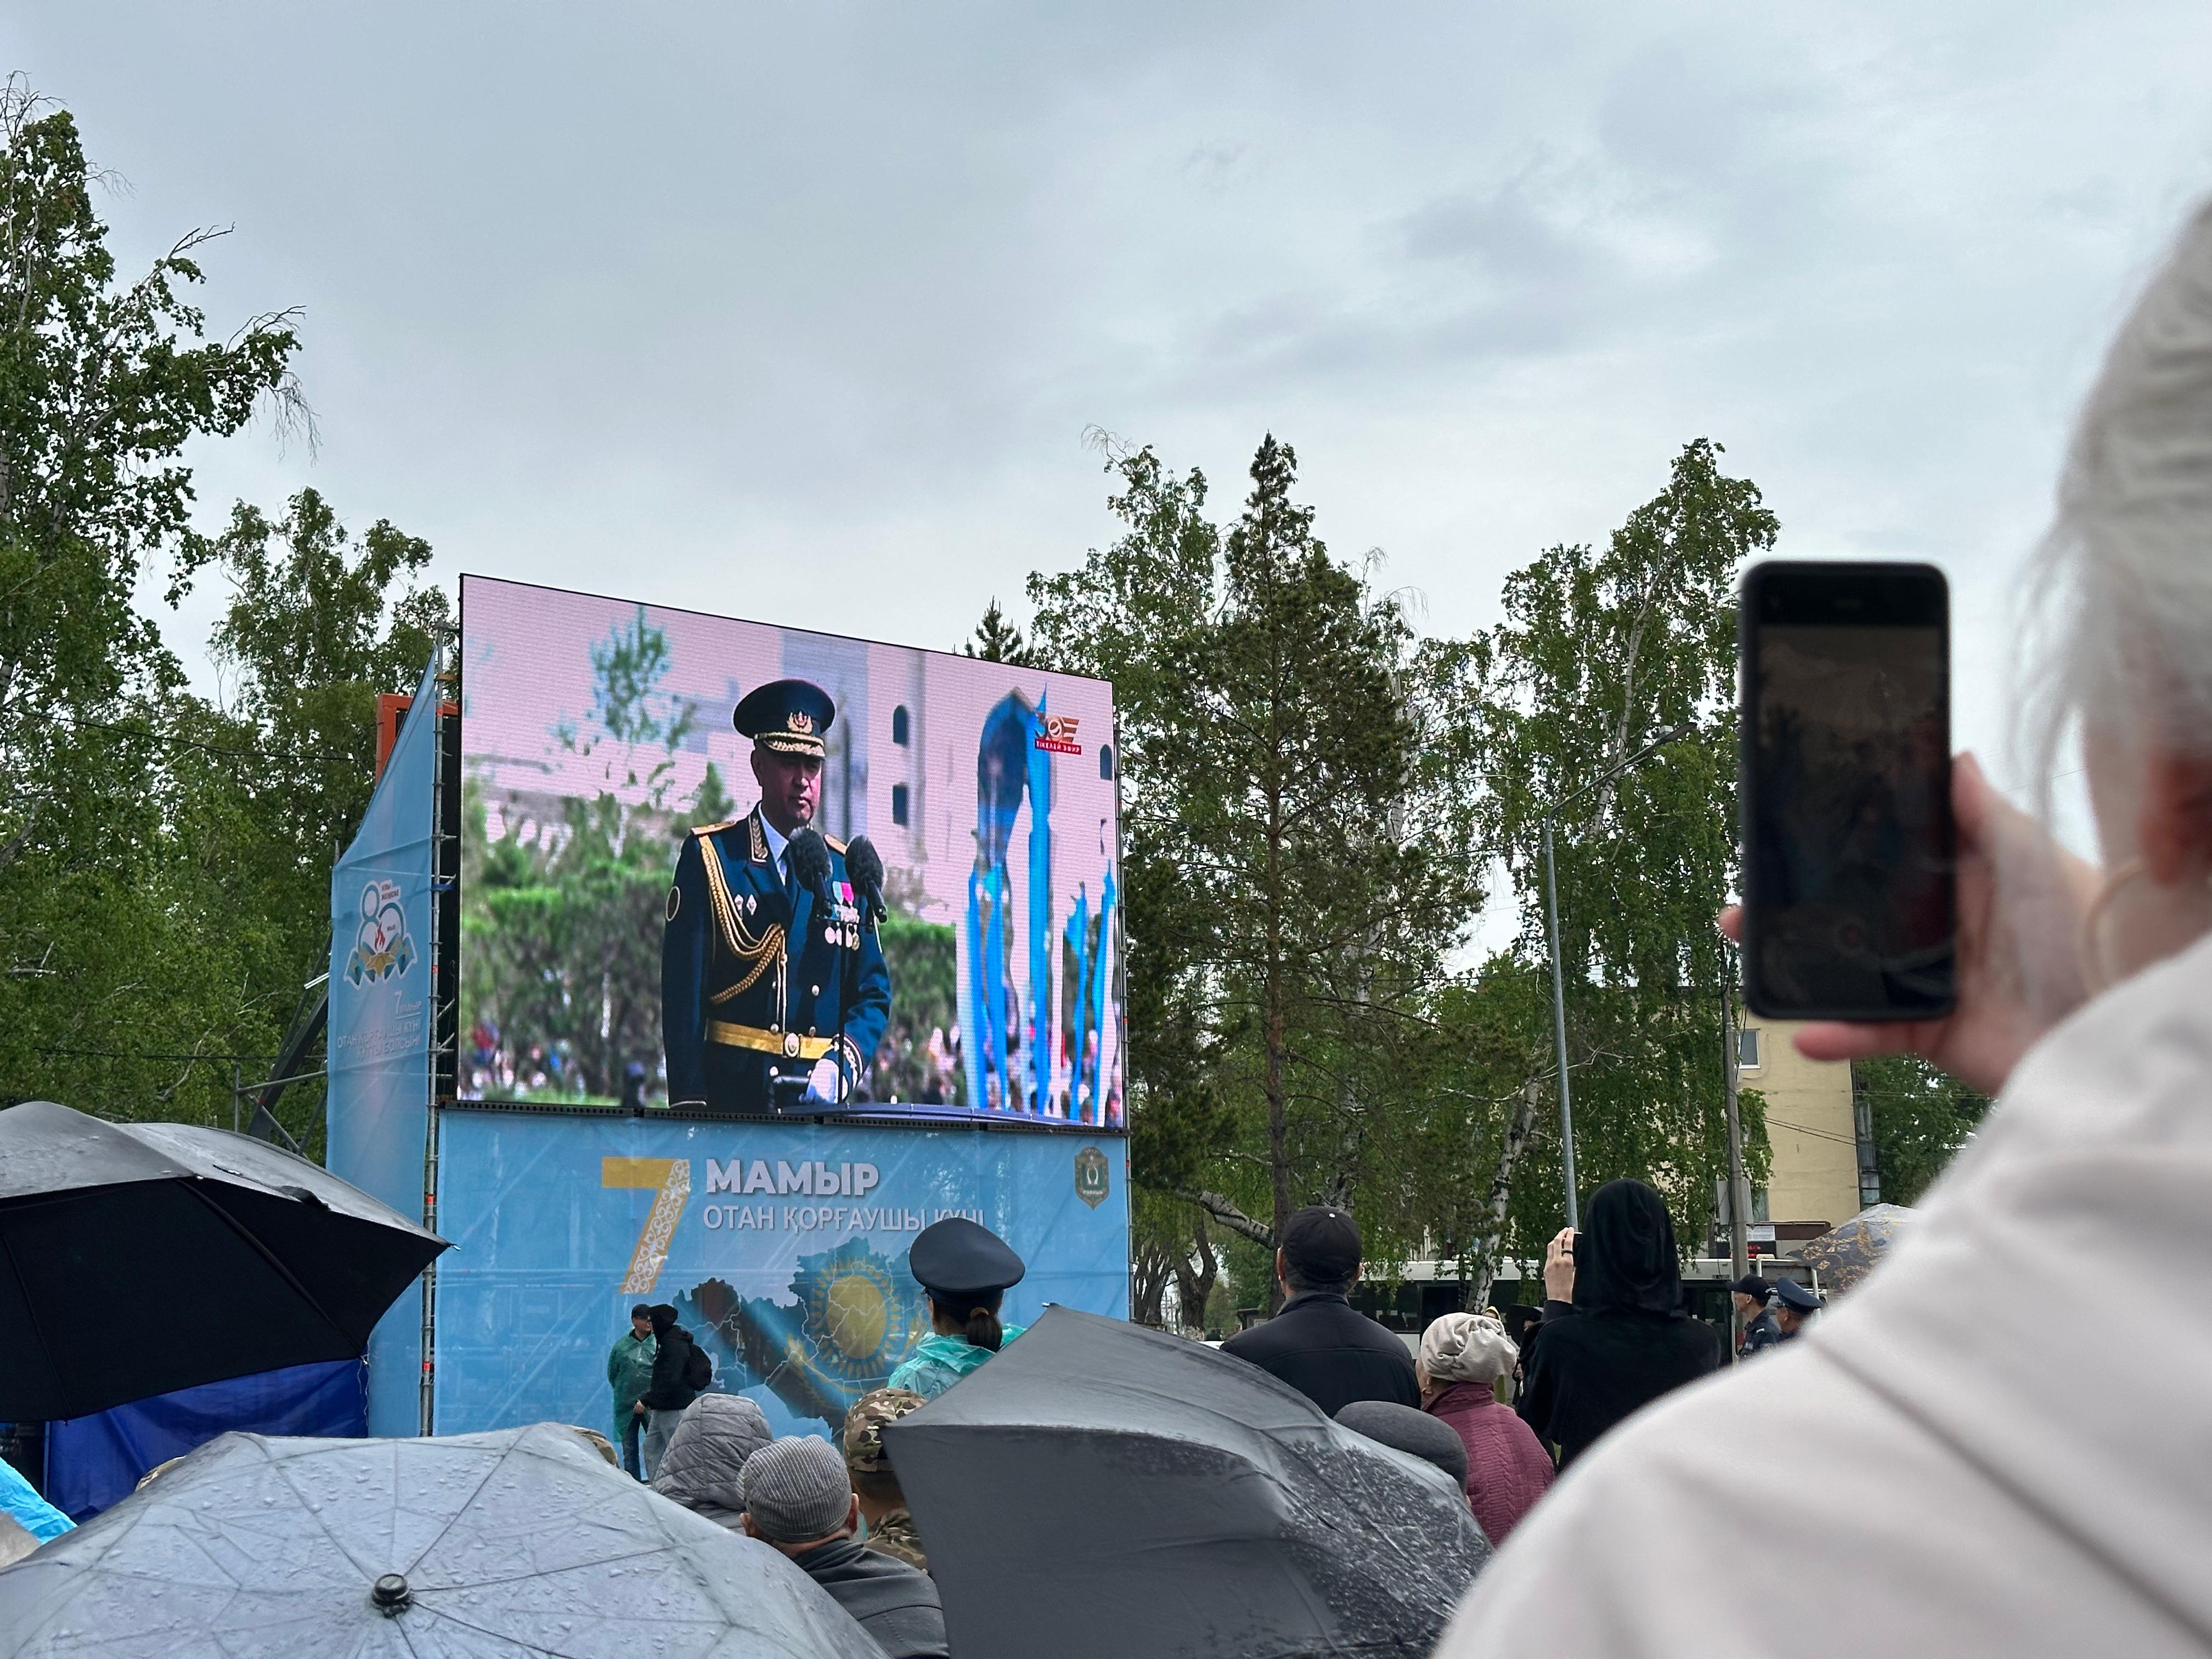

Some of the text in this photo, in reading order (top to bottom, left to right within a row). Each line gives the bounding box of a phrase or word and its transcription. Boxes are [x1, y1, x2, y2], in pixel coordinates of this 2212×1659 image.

[394, 990, 403, 1015] 7
[337, 1035, 358, 1049] ОТАН
[602, 1156, 879, 1295] 7 МАМЫР
[703, 1205, 775, 1230] ОТАН
[783, 1206, 926, 1234] ҚОРҒАУШЫ
